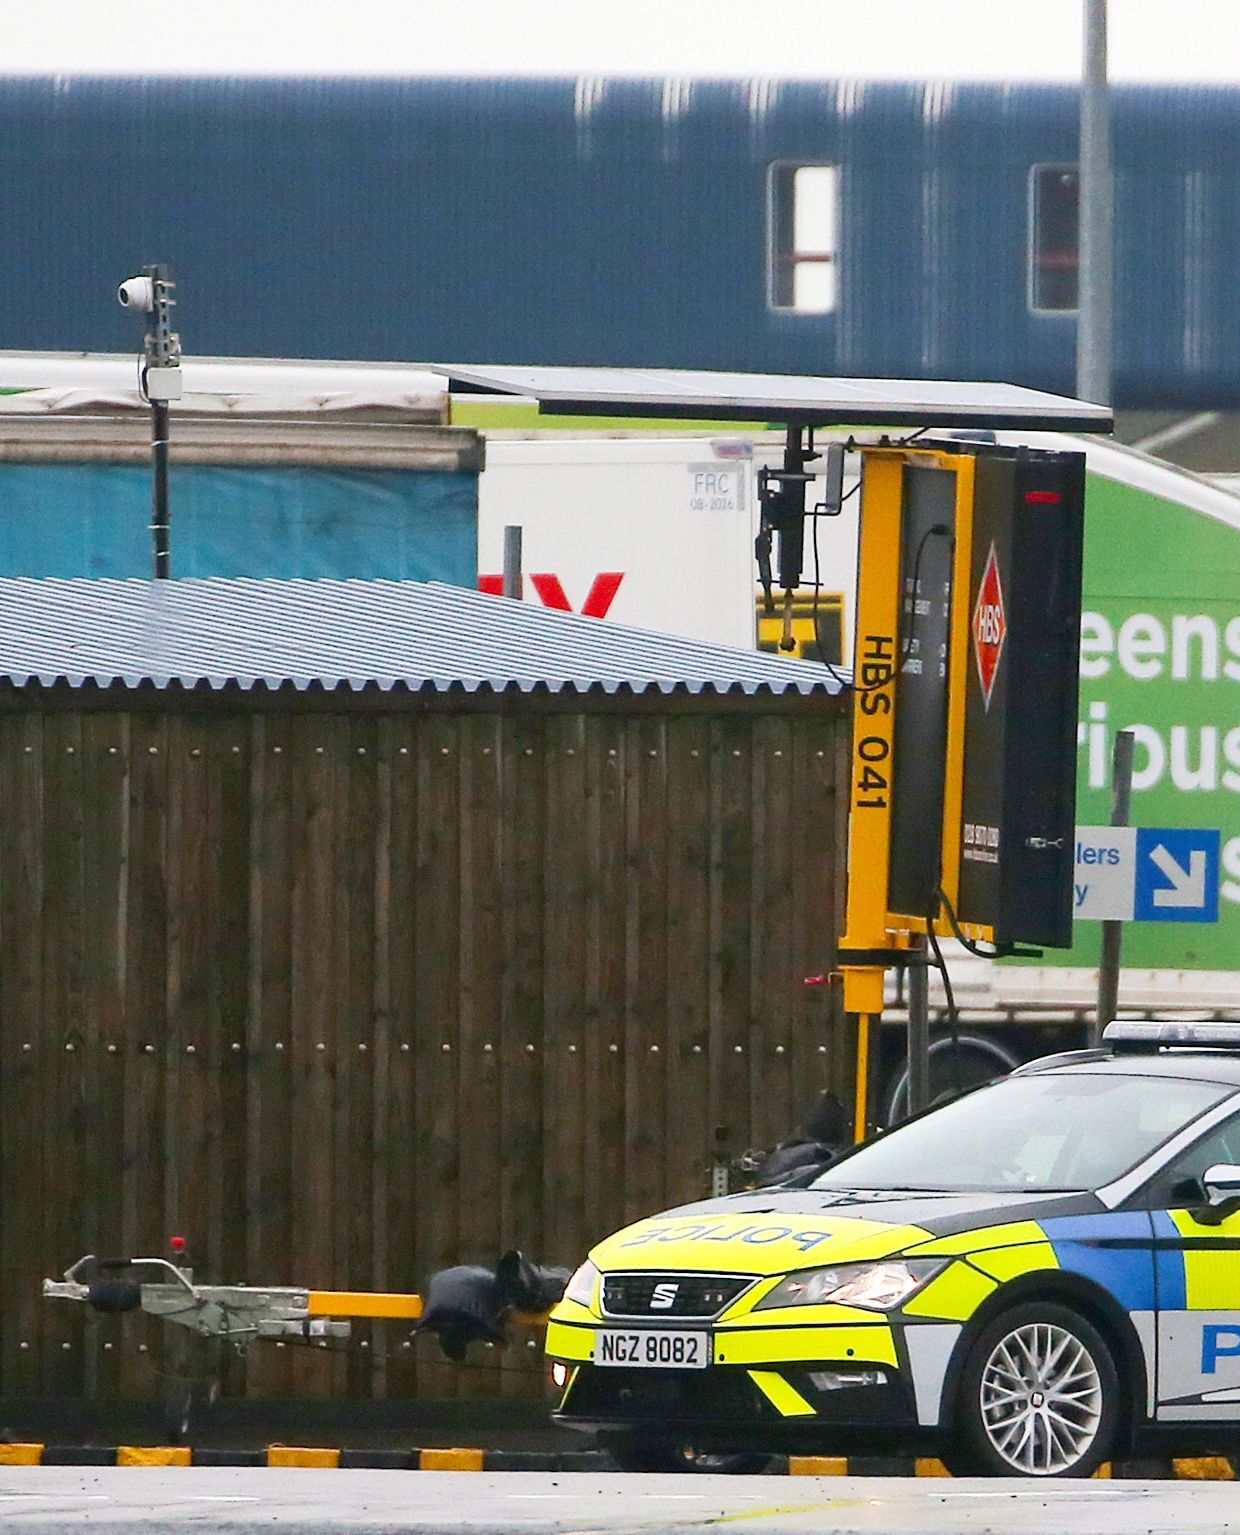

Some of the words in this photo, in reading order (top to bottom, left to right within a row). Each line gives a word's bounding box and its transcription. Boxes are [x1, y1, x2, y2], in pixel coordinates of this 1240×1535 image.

[978, 604, 1001, 645] HBS
[861, 635, 893, 715] HBS
[857, 736, 889, 809] 041
[1076, 842, 1120, 865] lers
[602, 1334, 641, 1363] NGZ
[646, 1336, 698, 1364] 8082
